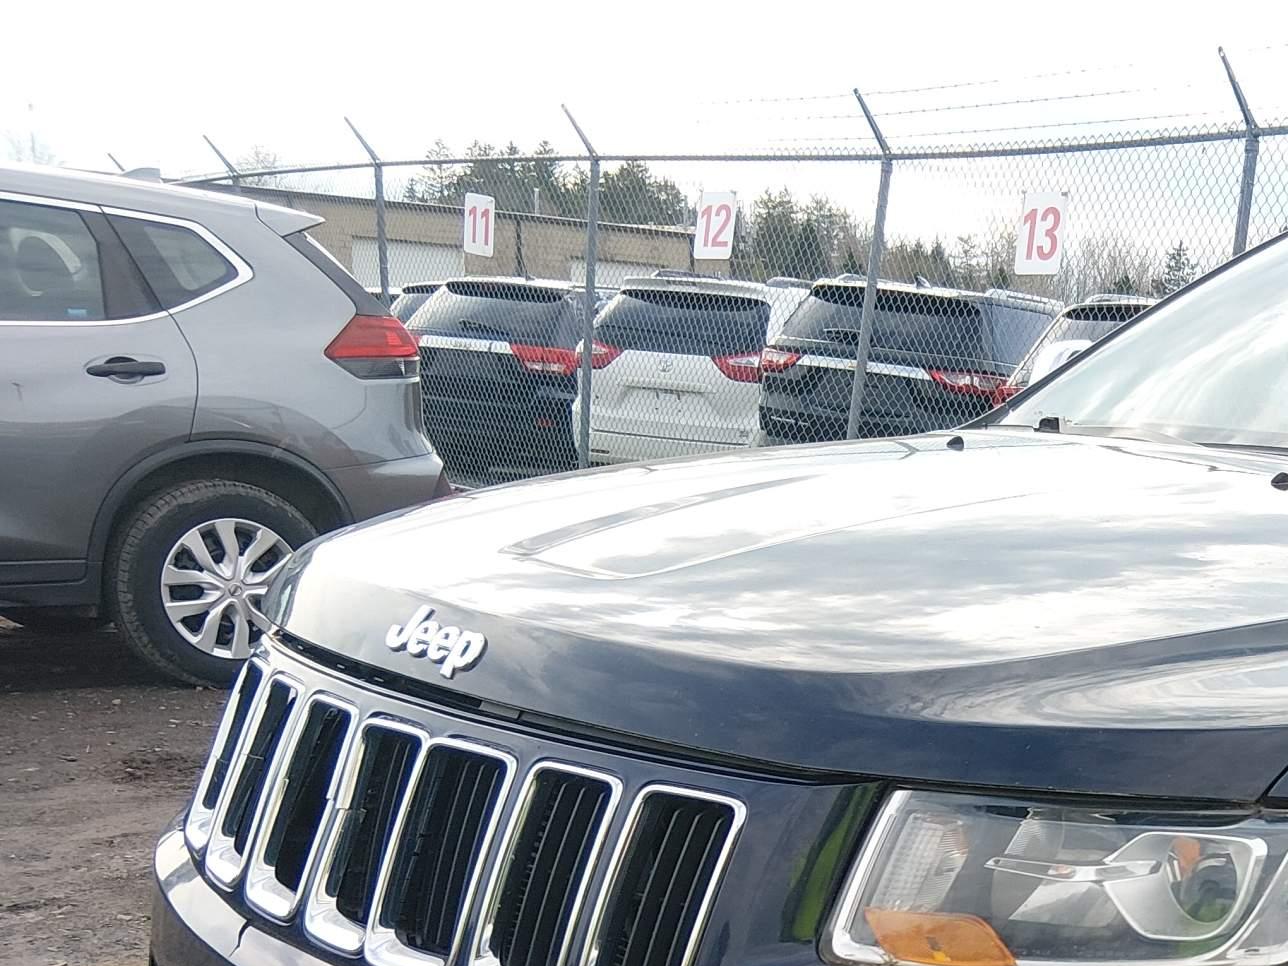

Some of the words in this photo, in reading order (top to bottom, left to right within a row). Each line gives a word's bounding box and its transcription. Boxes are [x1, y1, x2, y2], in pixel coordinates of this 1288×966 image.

[468, 206, 490, 247] 11
[701, 203, 732, 248] 12
[1023, 206, 1061, 261] 13
[385, 604, 488, 681] Jeep
